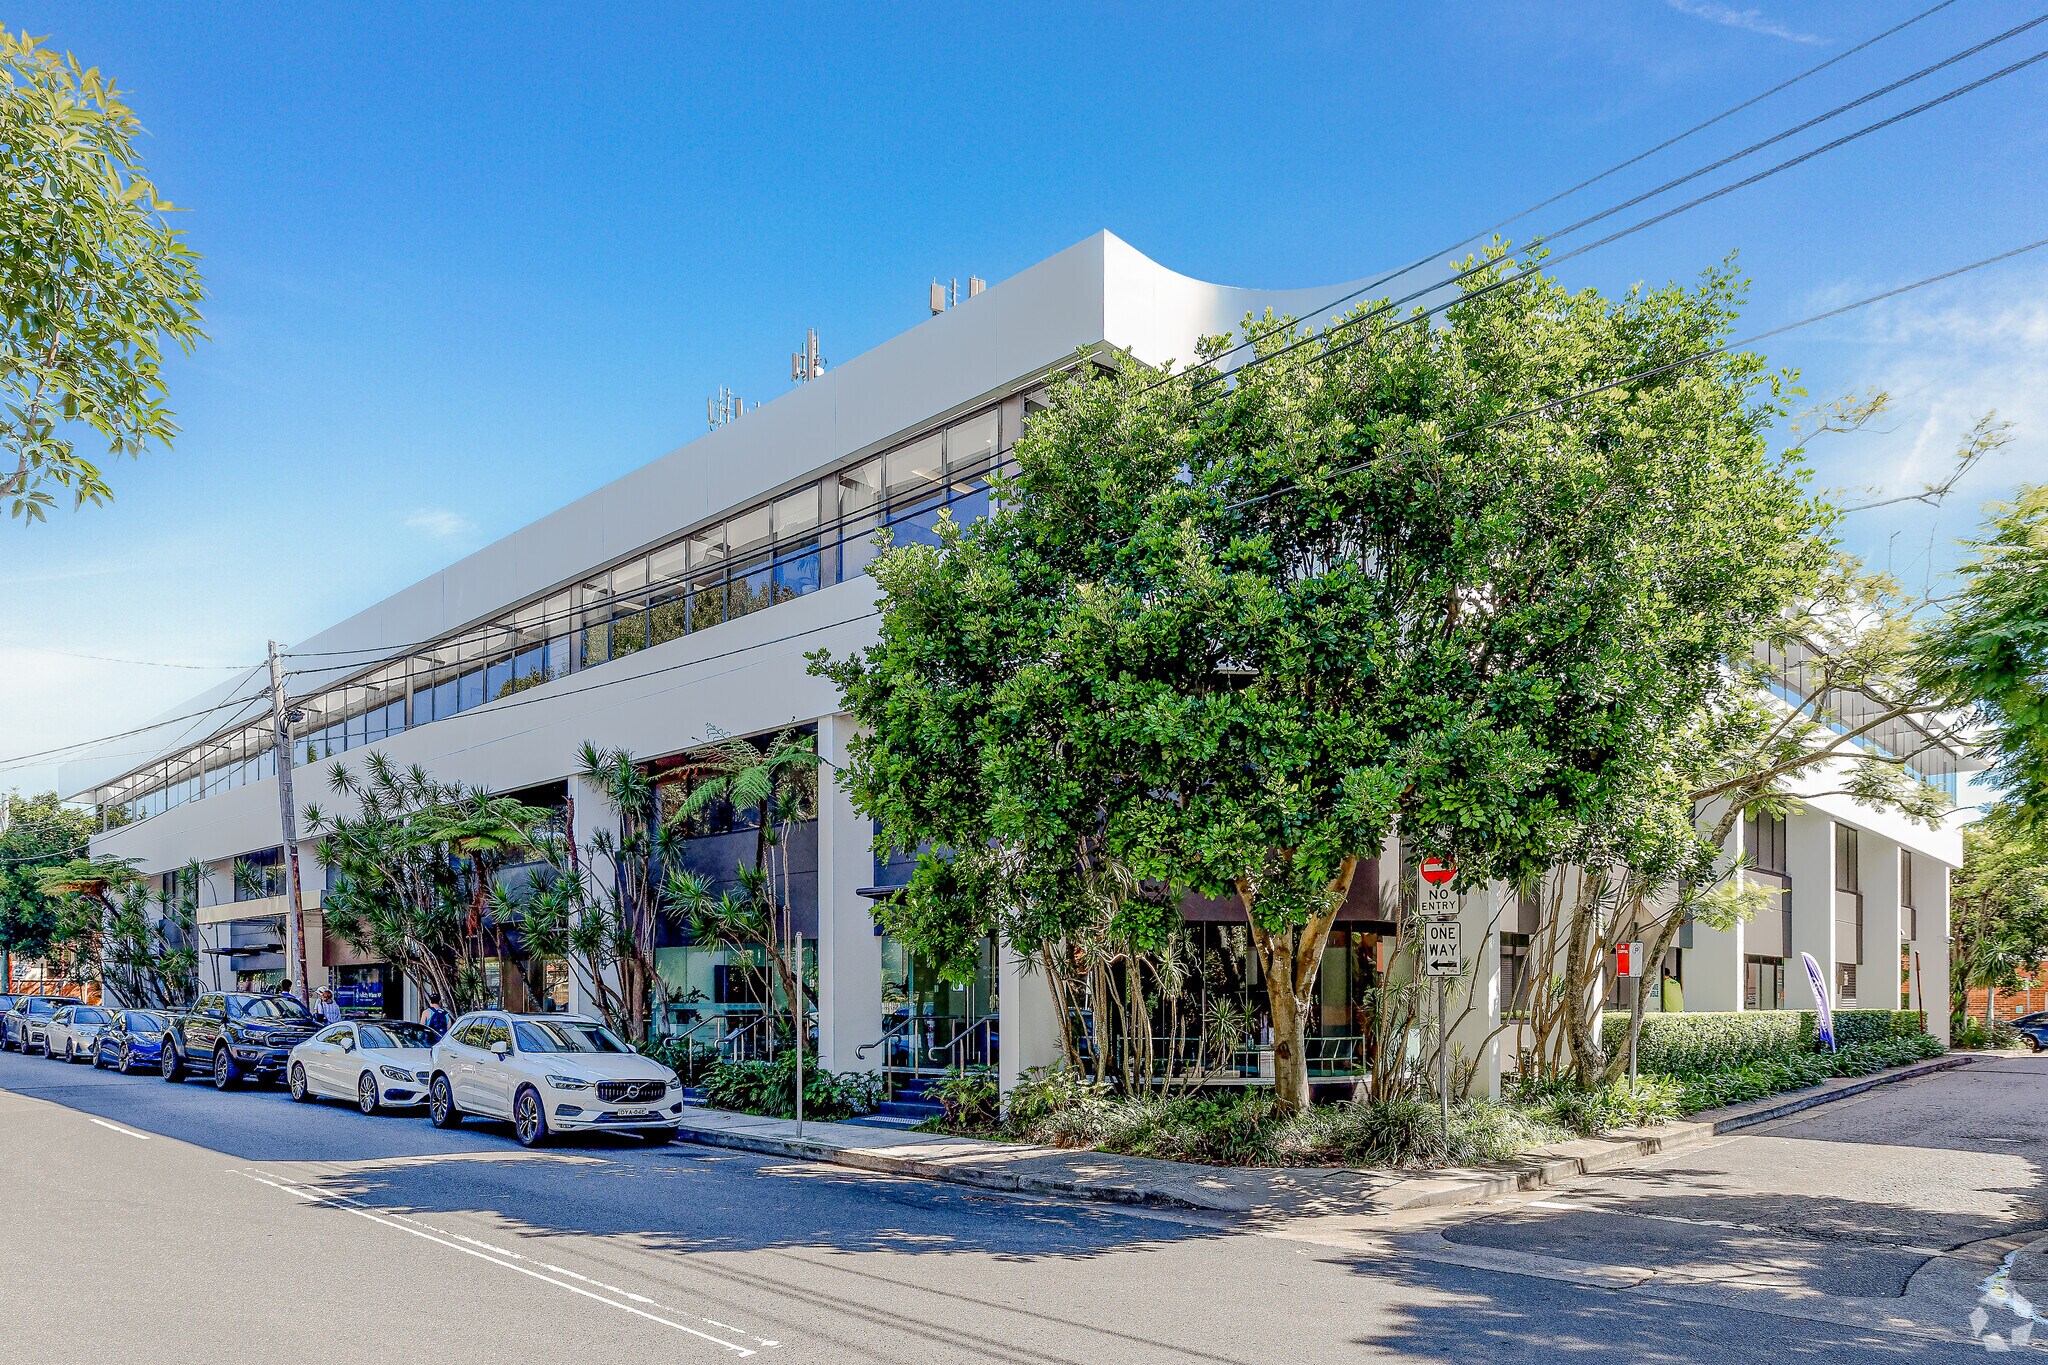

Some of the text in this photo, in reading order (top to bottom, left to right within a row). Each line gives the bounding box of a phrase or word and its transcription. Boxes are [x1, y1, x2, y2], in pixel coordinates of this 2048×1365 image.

[1429, 889, 1449, 900] NO
[1421, 900, 1456, 911] ENTRY
[1430, 927, 1456, 940] ONE
[1429, 943, 1457, 956] WAY
